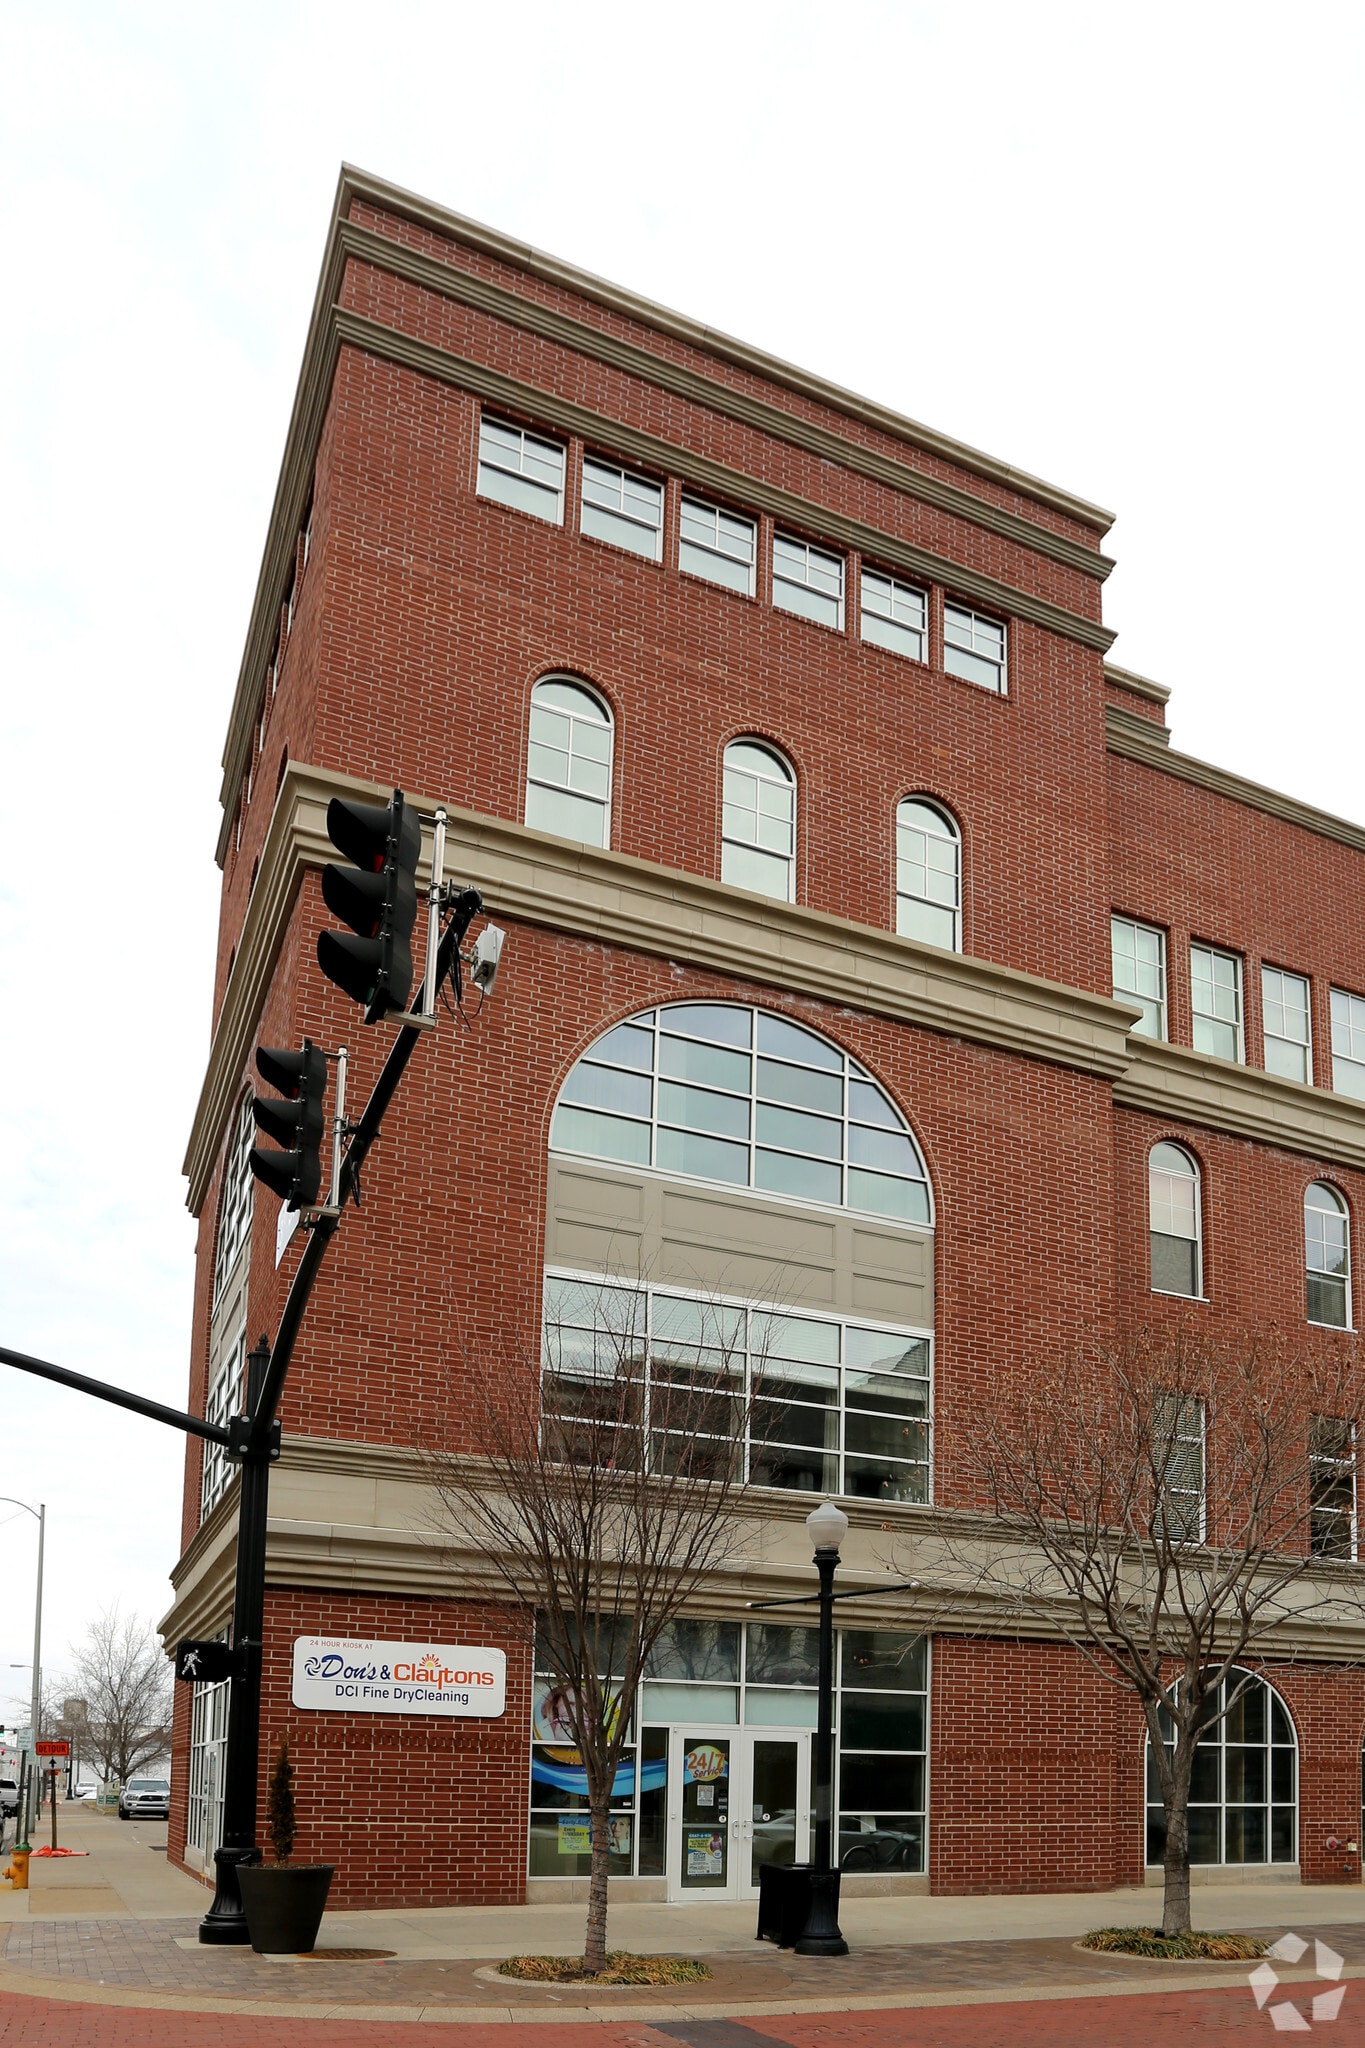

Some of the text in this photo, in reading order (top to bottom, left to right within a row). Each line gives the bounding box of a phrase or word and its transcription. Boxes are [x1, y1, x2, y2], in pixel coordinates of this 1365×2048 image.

[321, 1654, 495, 1690] Don's & Claytons
[335, 1685, 469, 1705] DCI Fine DryCleaning
[39, 1744, 66, 1753] DETOUR
[687, 1752, 725, 1771] 24/7
[693, 1766, 724, 1779] Service
